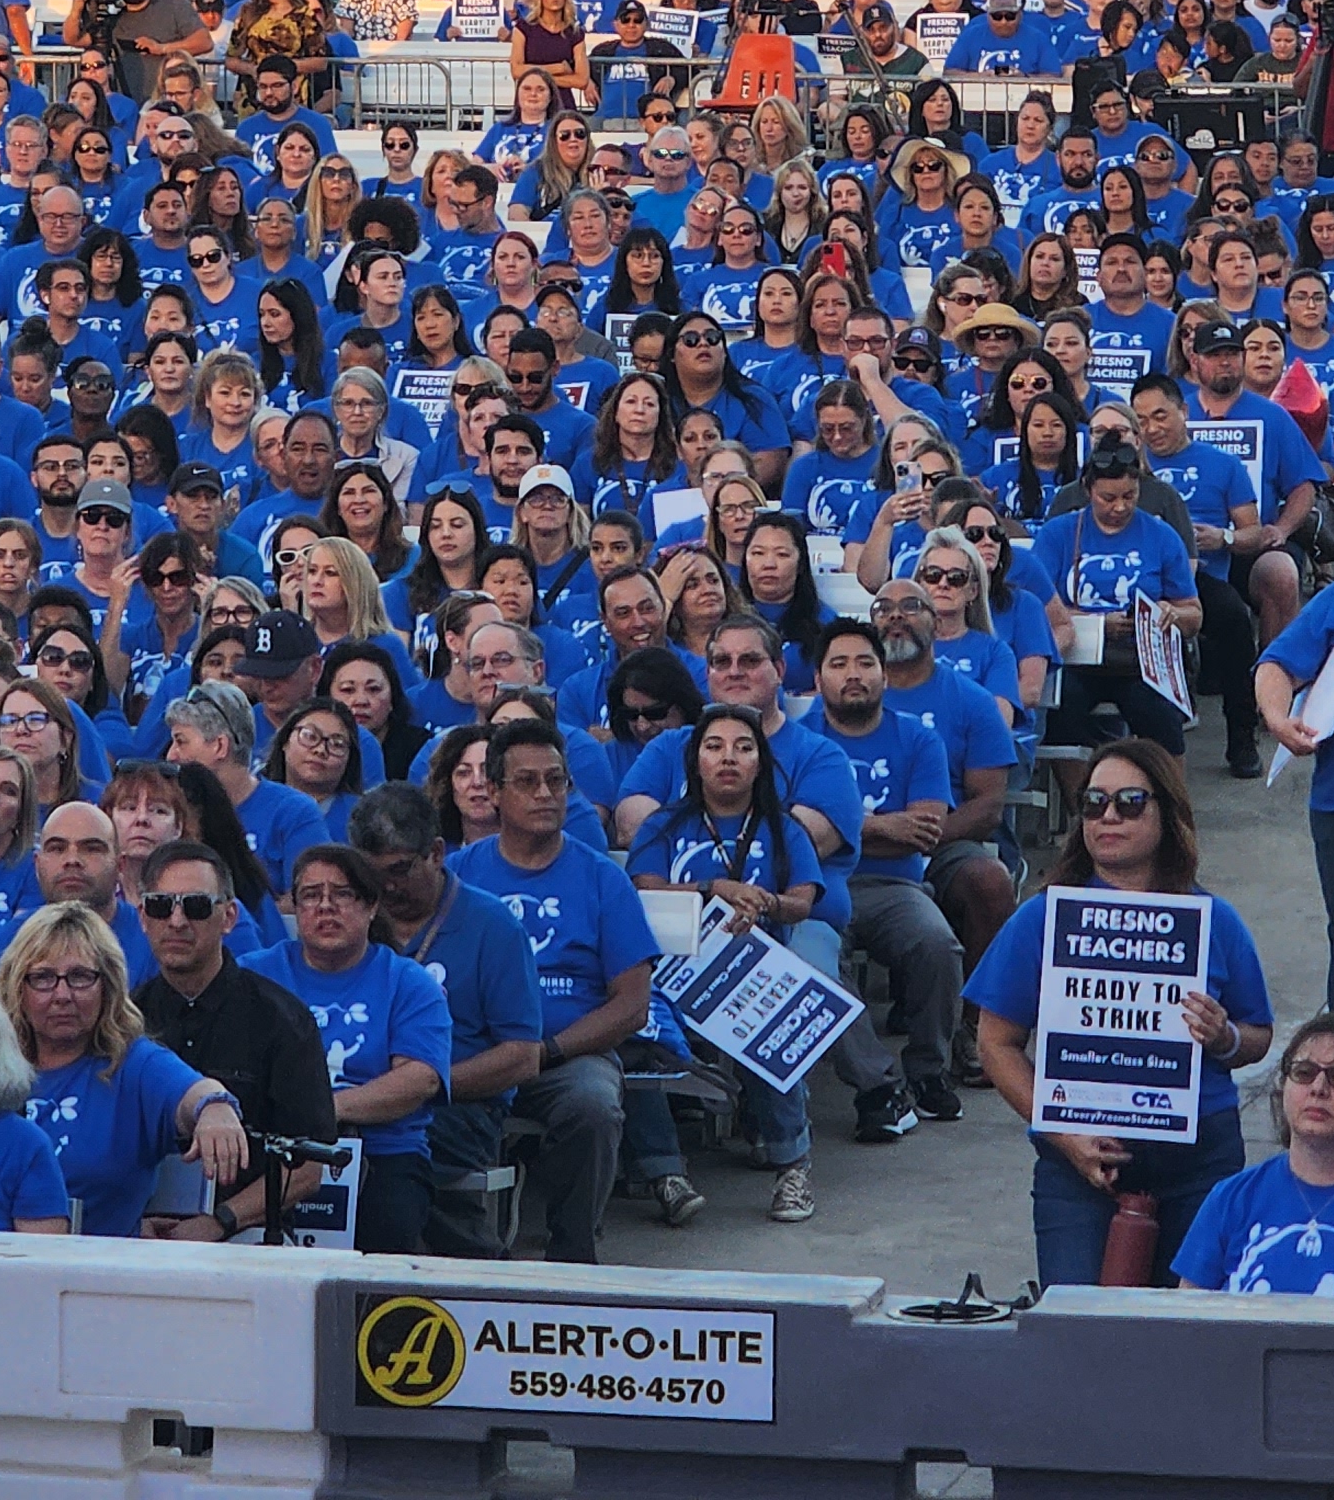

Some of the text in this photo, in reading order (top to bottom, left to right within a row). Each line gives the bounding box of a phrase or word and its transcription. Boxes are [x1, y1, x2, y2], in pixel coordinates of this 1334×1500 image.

[458, 6, 498, 15] TEACHERS
[655, 12, 687, 24] FRESNO
[649, 20, 690, 34] TEACHERS
[923, 26, 961, 36] TEACHERS
[926, 18, 958, 27] FRESNO
[412, 376, 451, 387] FRESN
[1087, 368, 1139, 380] EACHERS
[404, 386, 451, 397] TEACHE
[1193, 429, 1244, 442] FRESNO
[254, 628, 272, 653] B
[1080, 907, 1175, 934] FRESNO
[1065, 934, 1186, 964] TEACHERS
[721, 968, 773, 1021] STRIKE
[1064, 976, 1182, 1006] READY TO
[732, 971, 798, 1040] READY TO
[756, 987, 826, 1061] TEACHERS
[1080, 1005, 1163, 1033] STRIKE
[780, 1006, 837, 1065] FRESNO
[1059, 1048, 1178, 1071] Smaller Class Sizes
[1131, 1091, 1173, 1110] CTA
[1059, 1106, 1171, 1127] #EveryFresnoStudent
[295, 1201, 335, 1215] Smalle
